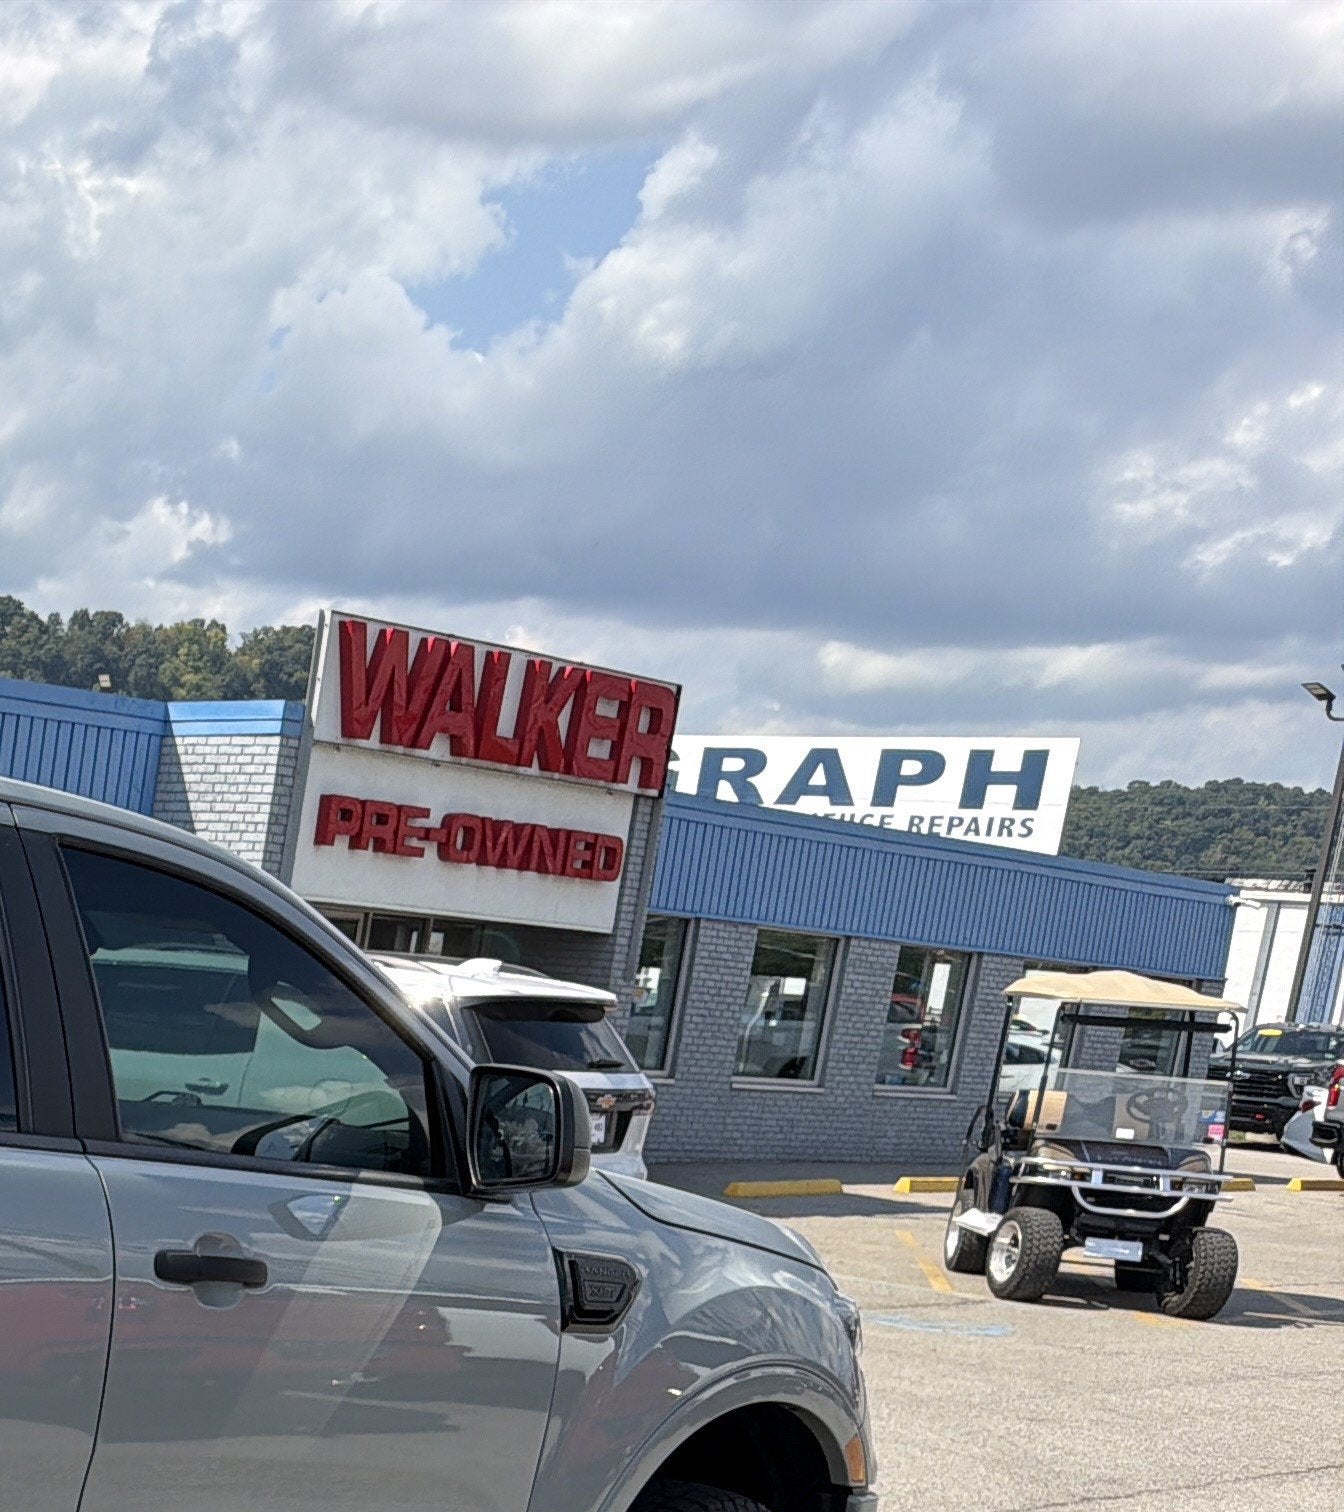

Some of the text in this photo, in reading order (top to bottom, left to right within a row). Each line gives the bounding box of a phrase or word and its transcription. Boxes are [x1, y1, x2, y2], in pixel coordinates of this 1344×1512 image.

[338, 619, 678, 791] WALKER
[313, 793, 624, 882] PRE-OWNED
[907, 815, 1035, 838] REPAIRS
